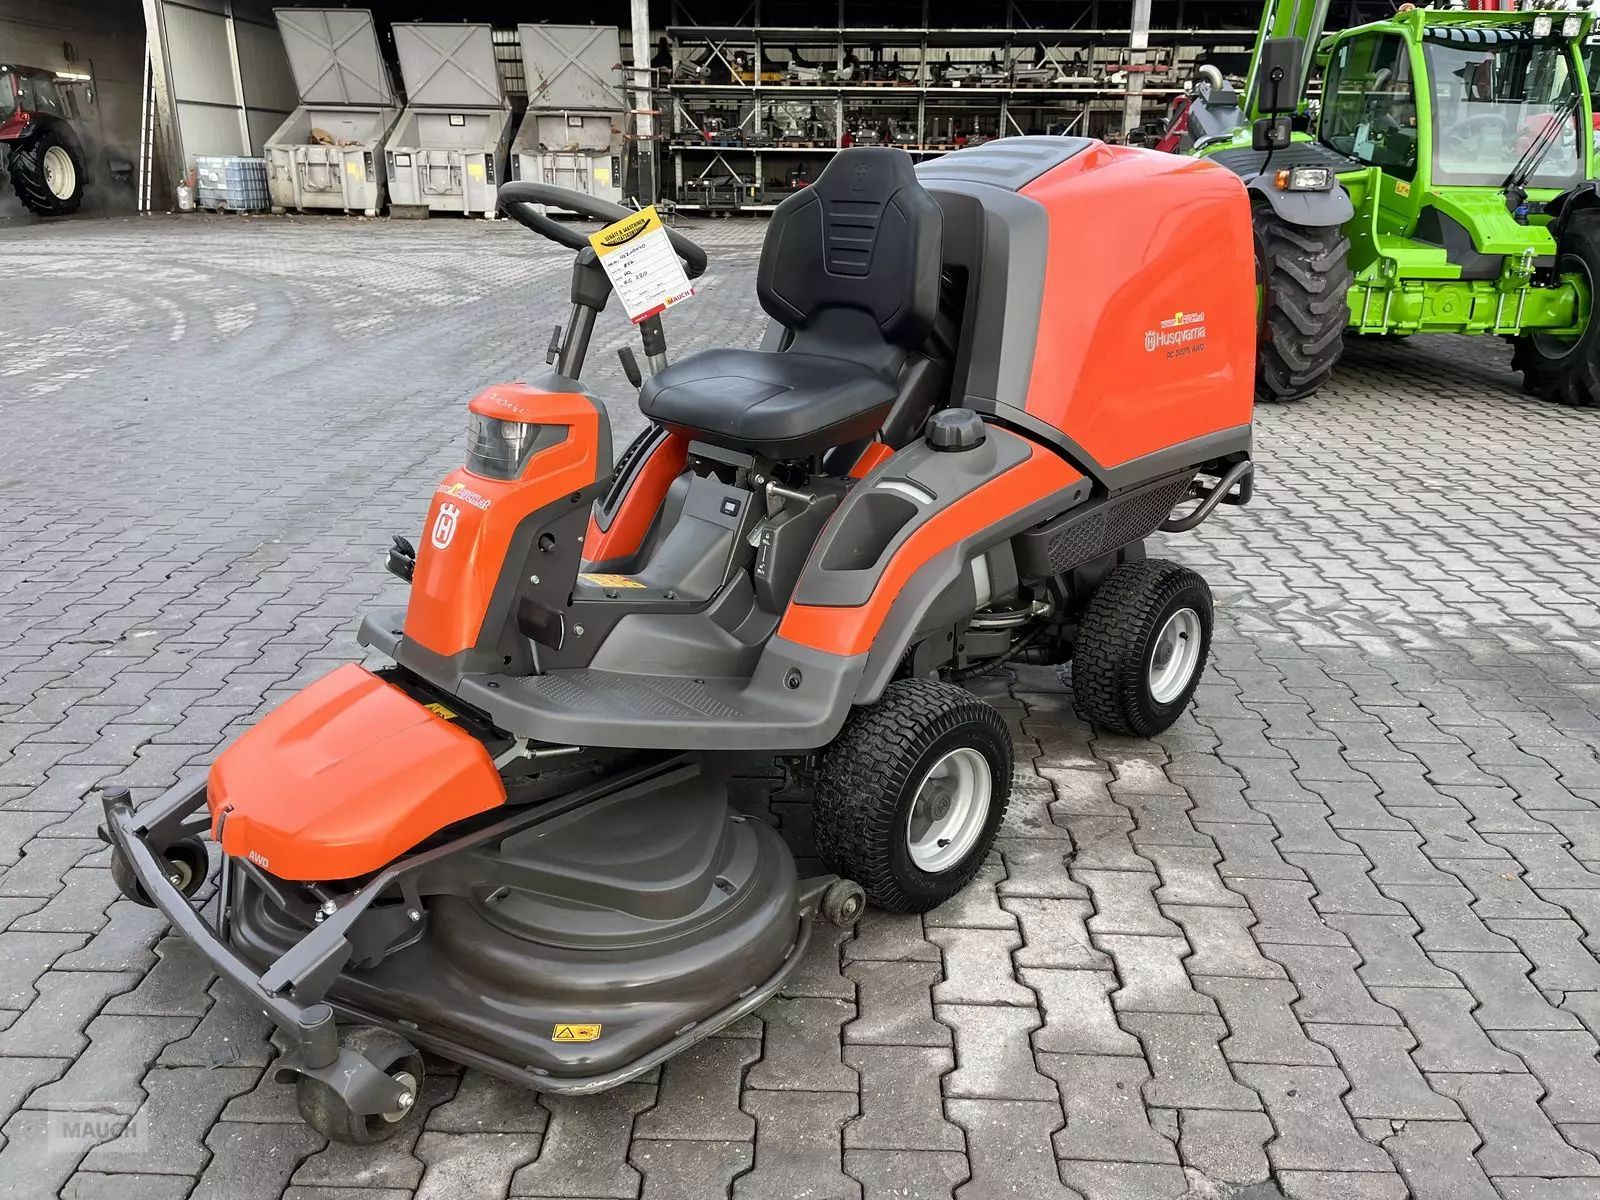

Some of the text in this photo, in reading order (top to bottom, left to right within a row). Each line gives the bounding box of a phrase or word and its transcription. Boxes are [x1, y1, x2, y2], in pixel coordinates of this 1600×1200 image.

[622, 218, 646, 232] MASCHINEN
[634, 271, 648, 280] 320
[667, 290, 690, 305] MAUCH
[1156, 326, 1206, 347] Husqvarna
[1192, 343, 1205, 352] AWD
[248, 849, 269, 868] AWD
